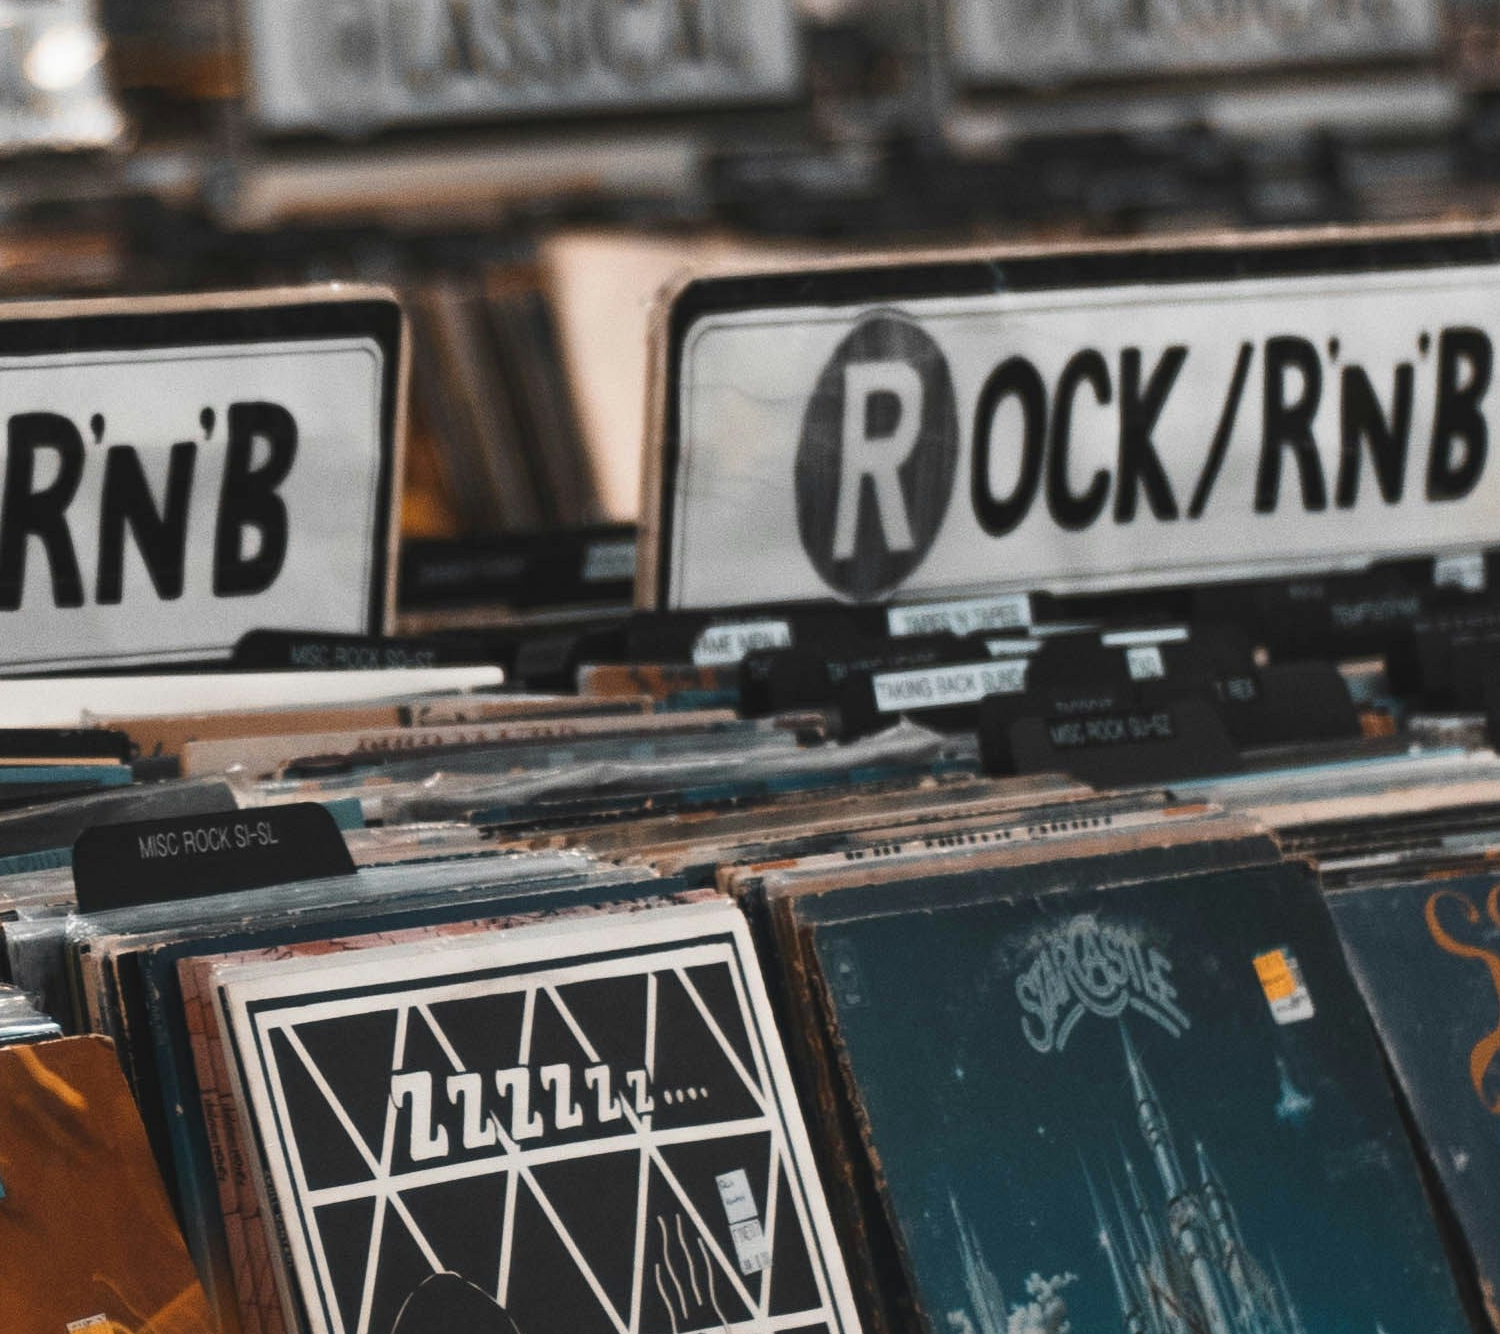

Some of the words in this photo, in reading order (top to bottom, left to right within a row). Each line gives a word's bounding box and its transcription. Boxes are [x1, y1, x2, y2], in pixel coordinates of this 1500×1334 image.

[834, 327, 1494, 560] ROCK/R'N'B
[138, 835, 179, 859] MISC
[183, 829, 229, 854] ROCK
[235, 823, 279, 848] SI-SL
